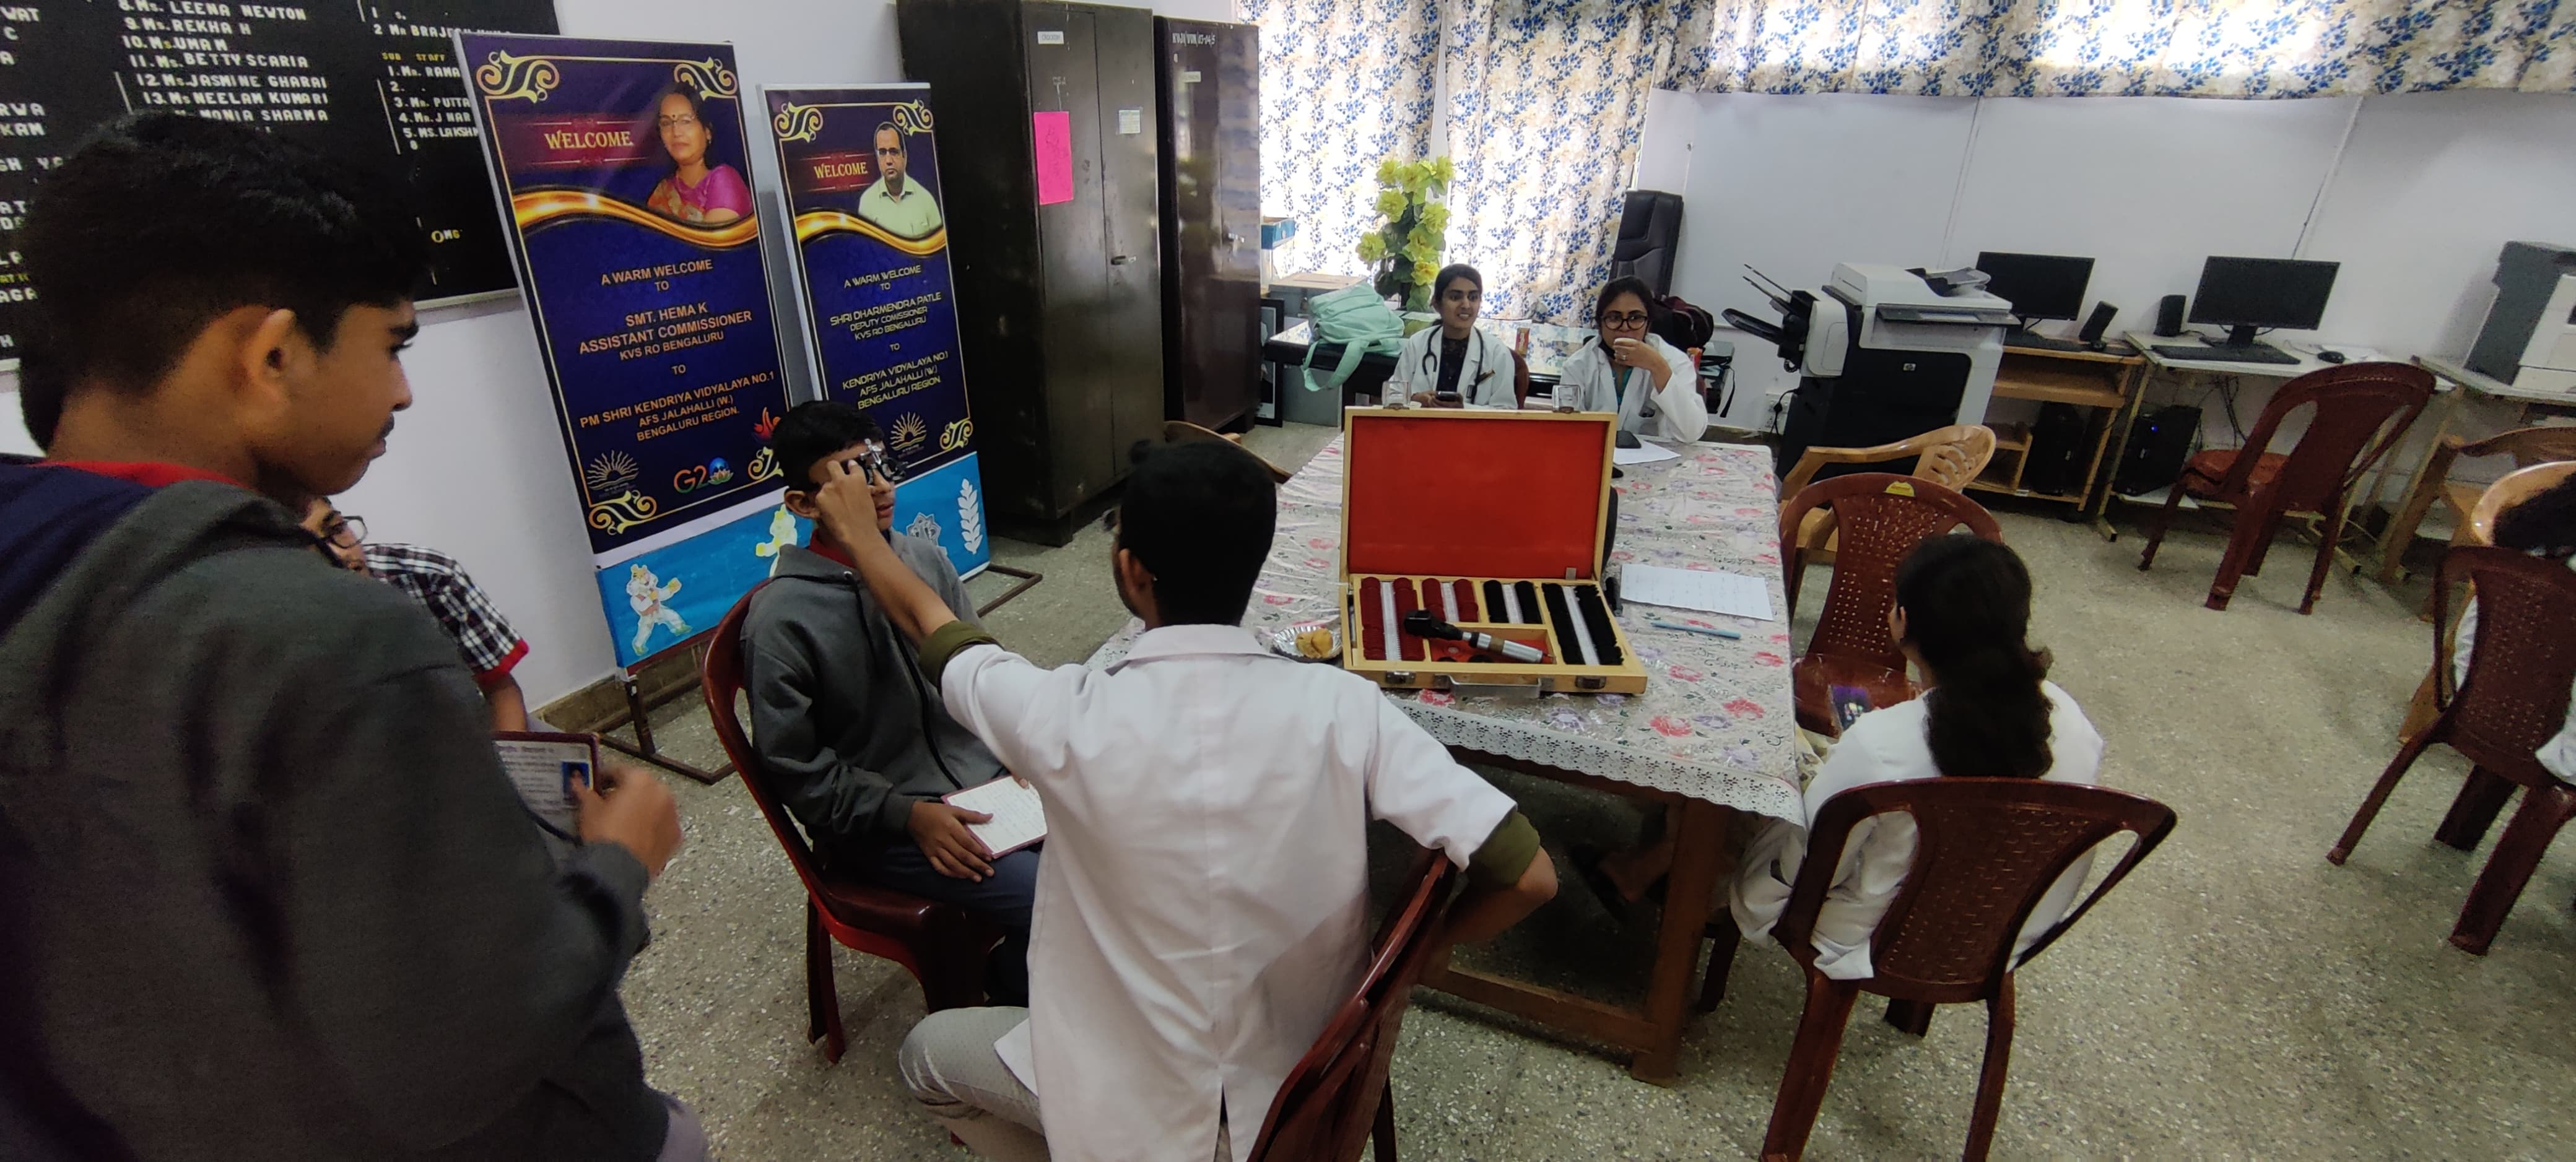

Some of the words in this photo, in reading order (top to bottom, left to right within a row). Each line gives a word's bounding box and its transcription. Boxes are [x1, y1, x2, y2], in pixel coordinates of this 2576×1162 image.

[170, 1, 230, 17] LEENA
[240, 4, 306, 20] NEWTON
[172, 19, 232, 34] REKHA
[373, 24, 383, 35] 2
[183, 53, 240, 66] BETTY
[246, 54, 308, 68] SCARIA
[268, 76, 328, 89] GHARAI
[193, 92, 264, 104] NEELAM
[268, 92, 328, 104] KUMARI
[260, 110, 328, 121] SHARMA
[544, 129, 634, 150] WELCOME
[813, 162, 868, 180] WELCOME
[601, 274, 611, 286] A
[611, 267, 651, 283] WARM
[653, 259, 713, 277] WELCOME
[843, 279, 851, 289] A
[851, 273, 881, 287] WARM
[881, 264, 921, 280] WELCOME
[654, 280, 669, 292] TO
[879, 282, 891, 291] TO
[625, 311, 656, 327] SMT.
[659, 304, 697, 321] HEMA
[698, 301, 708, 314] K
[830, 313, 853, 326] SHRI
[853, 298, 916, 320] DHARMENDRA
[916, 292, 942, 306] PATLE
[579, 329, 655, 355] ASSISTANT
[658, 310, 752, 339] COMMISSIONER
[850, 317, 879, 332] DEPUTY
[855, 329, 872, 341] KVS
[872, 326, 884, 336] RO
[884, 316, 927, 334] BENGALURU
[619, 347, 643, 361] KVS
[645, 344, 661, 356] RO
[663, 331, 724, 352] BENGALURU
[889, 342, 900, 351] TO
[671, 364, 687, 375] TO
[842, 370, 887, 391] KENDRIYA
[887, 356, 933, 376] VIDYALAYA
[857, 385, 910, 410] BENGALURU
[910, 375, 941, 392] REGION
[859, 384, 878, 397] AFS
[879, 370, 923, 391] JALAHALLI
[580, 415, 600, 428] PM
[602, 405, 632, 423] SHRI
[634, 388, 693, 414] KENDRIYA
[693, 378, 751, 399] VIDYALAYA
[751, 371, 775, 385] NO.1
[638, 415, 660, 428] AFS
[661, 399, 715, 421] JALAHALLI
[636, 415, 699, 442] BENGALURU
